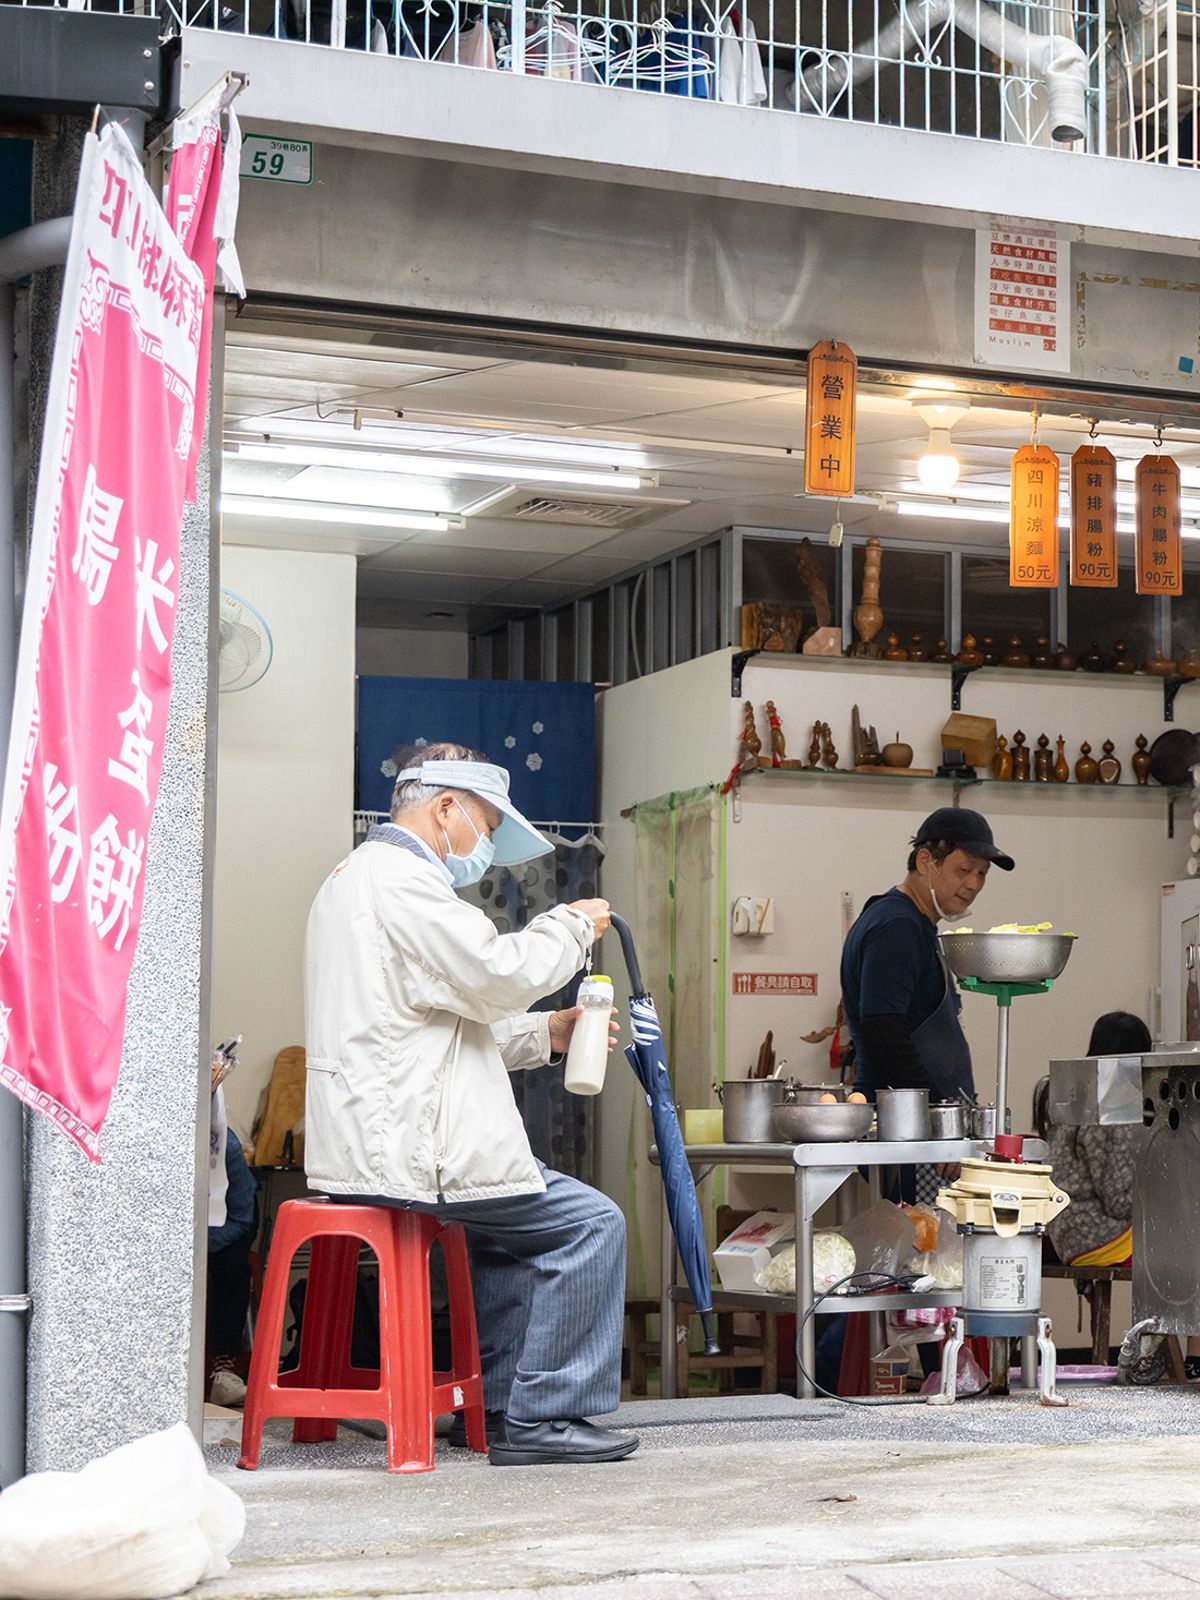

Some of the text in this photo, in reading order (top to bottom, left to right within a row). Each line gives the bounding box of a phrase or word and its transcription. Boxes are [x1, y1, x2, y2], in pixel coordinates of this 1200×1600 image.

[252, 151, 284, 176] 59
[820, 375, 845, 478] 營業中
[1026, 470, 1044, 556] 四川涼麵
[1087, 473, 1103, 556] 豬排腸粉
[1151, 481, 1168, 565] 牛肉腸粉
[1018, 565, 1051, 580] 50元
[1080, 563, 1111, 579] 90元
[1145, 570, 1176, 587] 90元
[88, 532, 176, 951] 米蛋餅
[754, 975, 813, 989] 餐具請自取
